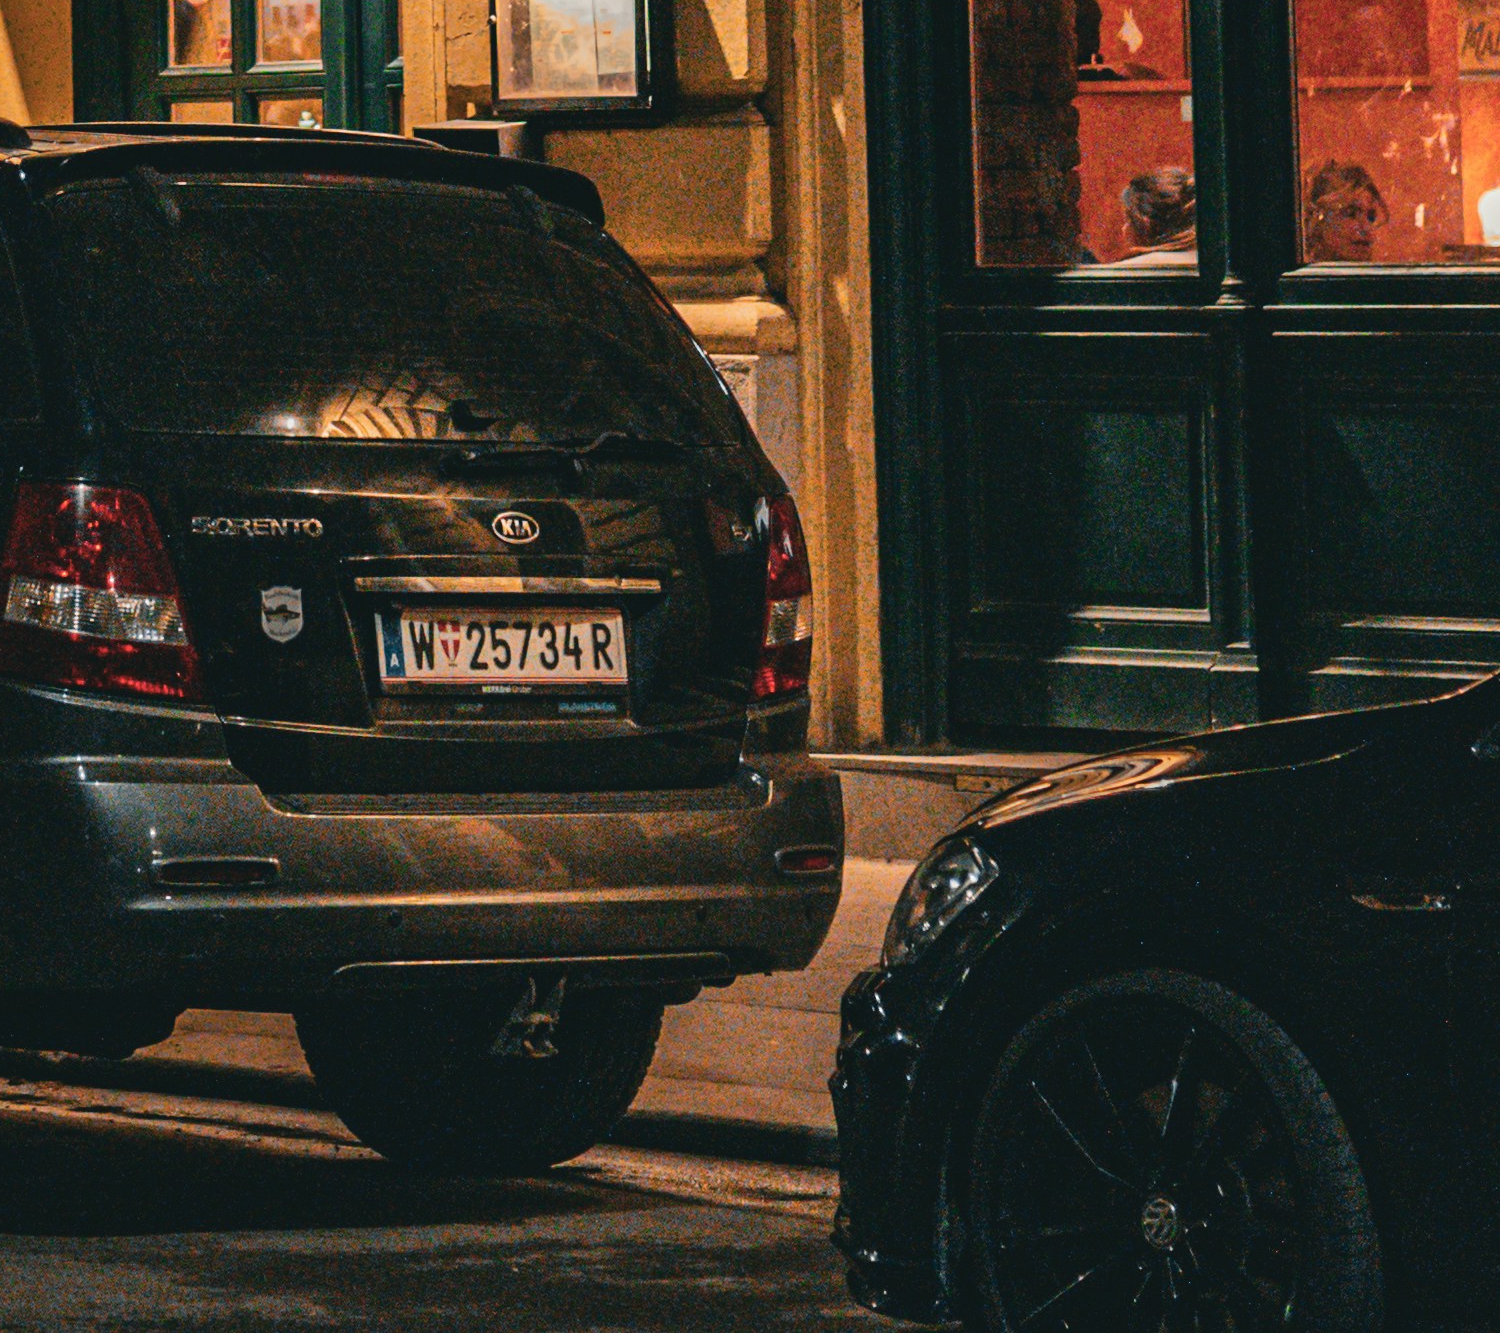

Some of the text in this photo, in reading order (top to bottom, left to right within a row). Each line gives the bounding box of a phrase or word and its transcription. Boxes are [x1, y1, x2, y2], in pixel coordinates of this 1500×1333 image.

[191, 516, 324, 537] SORENTO
[501, 518, 531, 536] KIA
[408, 620, 614, 671] W 25734 R
[389, 653, 399, 668] A
